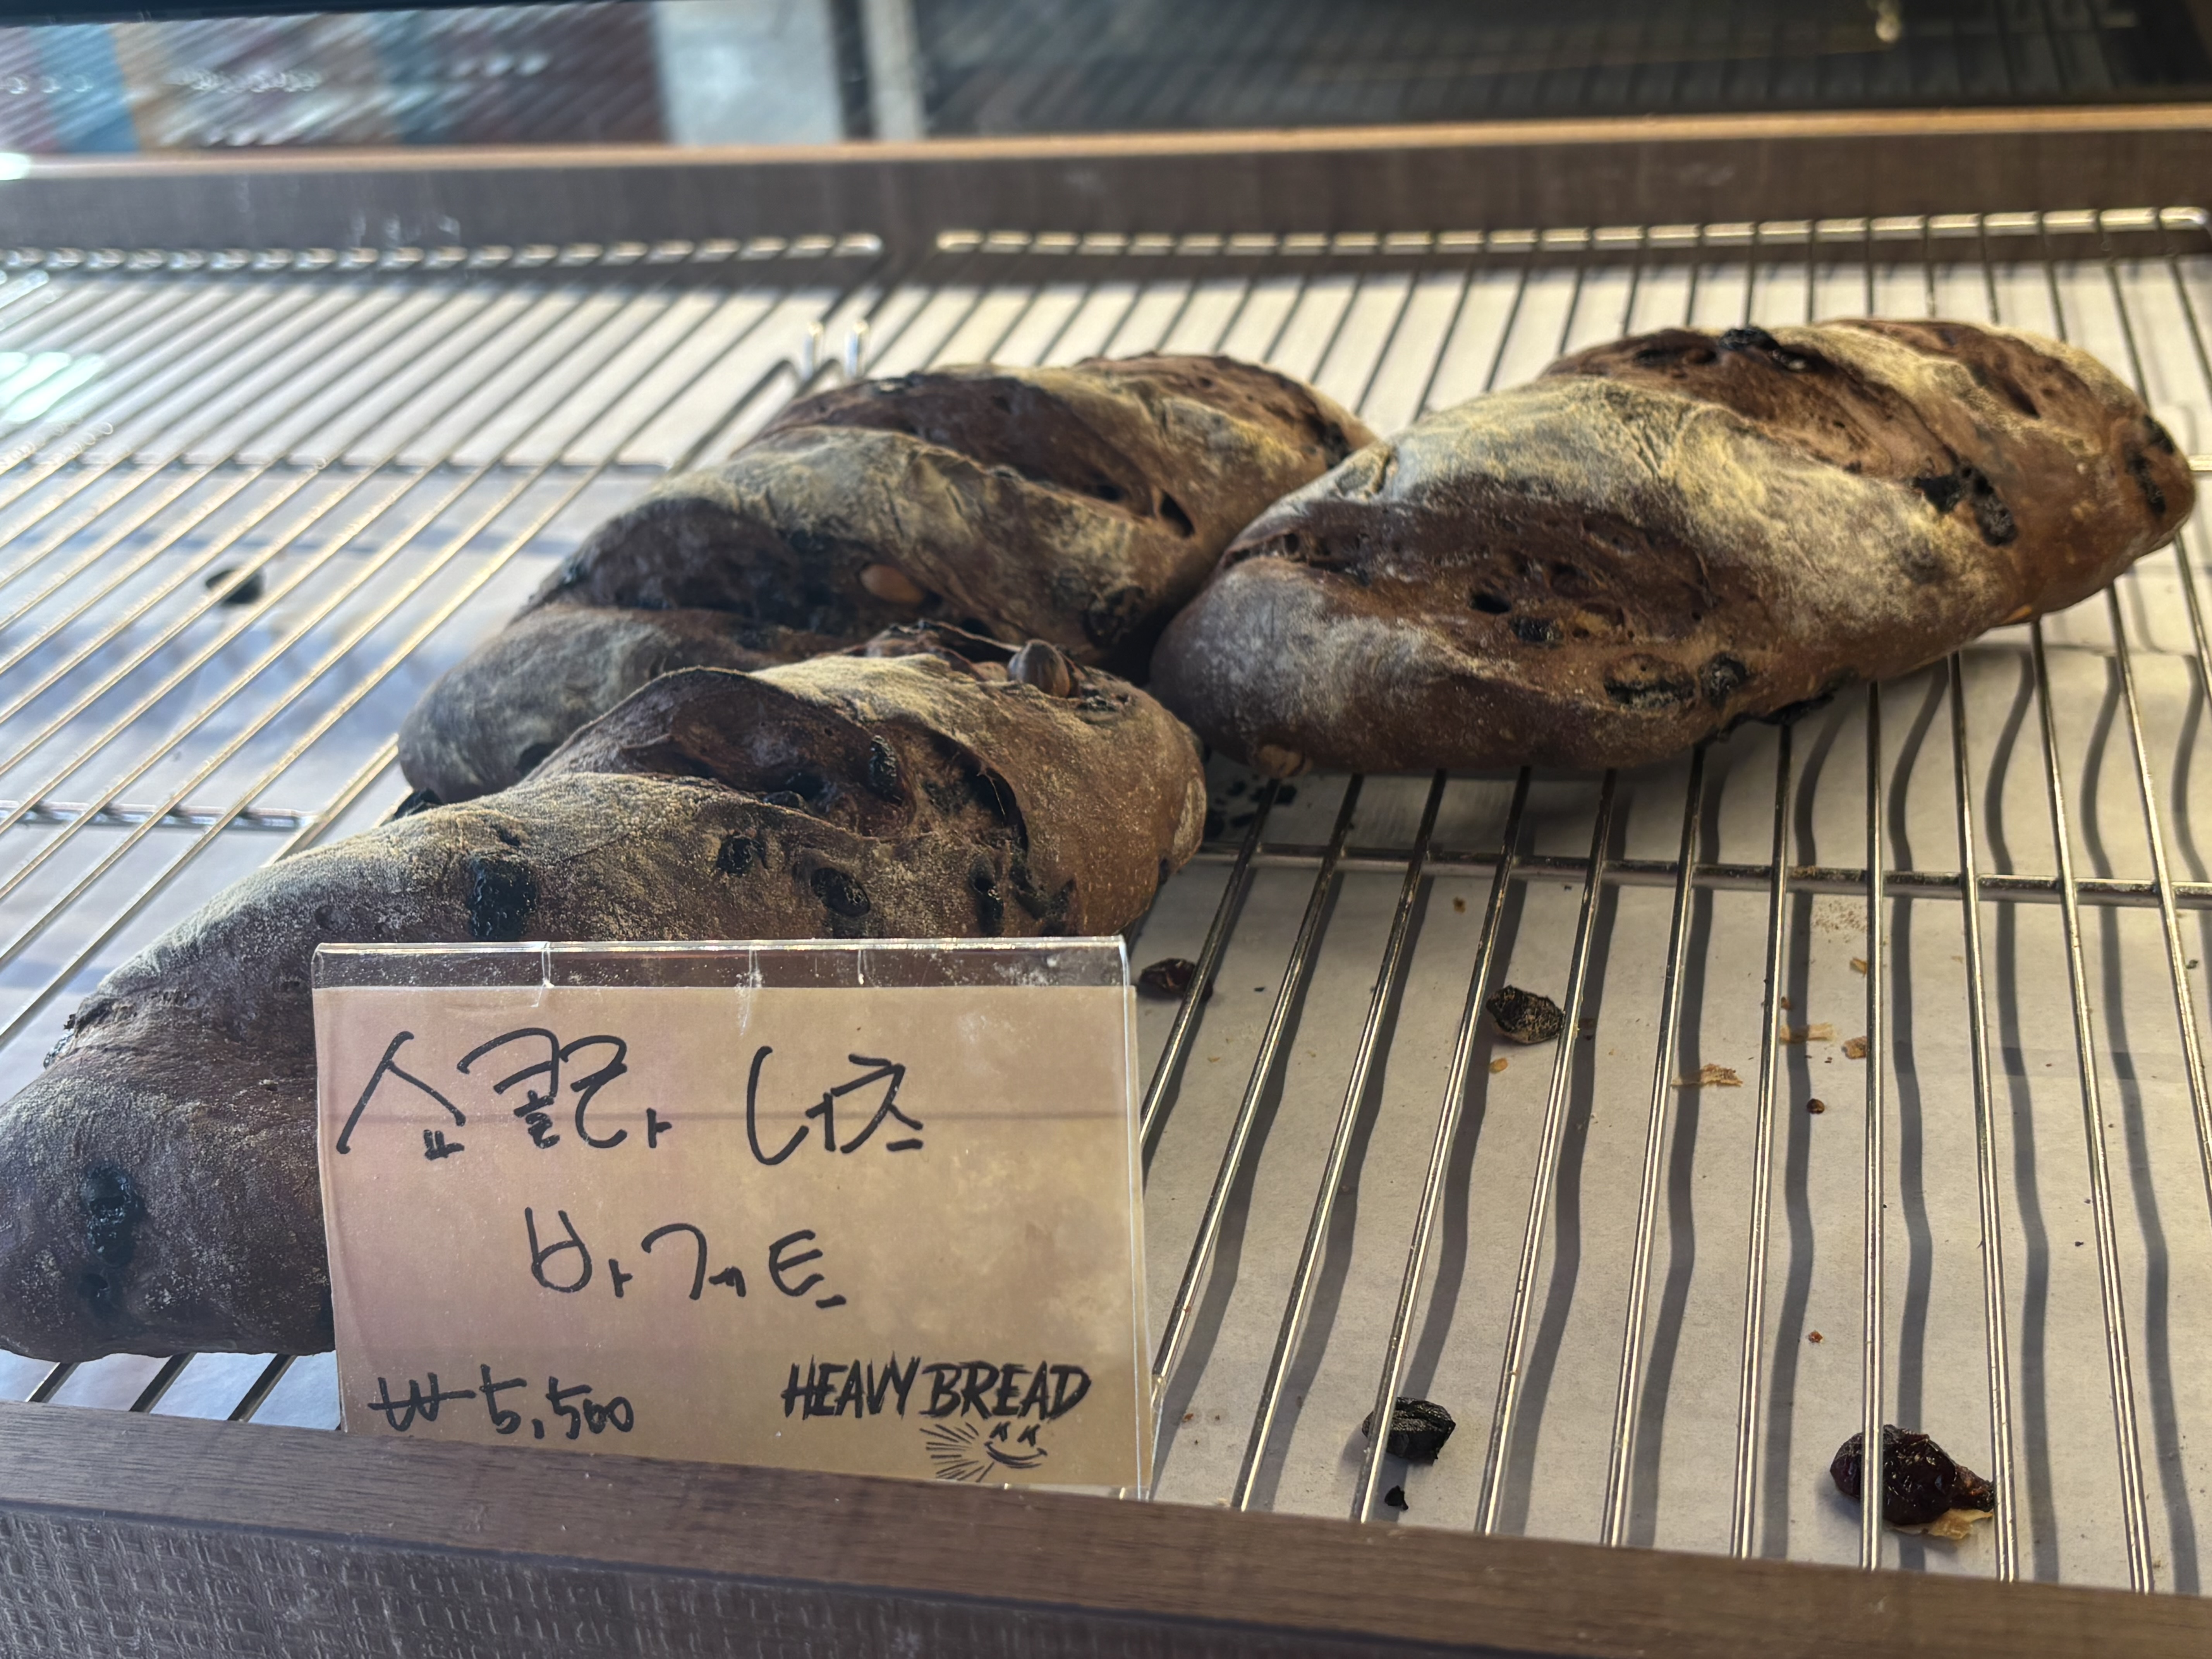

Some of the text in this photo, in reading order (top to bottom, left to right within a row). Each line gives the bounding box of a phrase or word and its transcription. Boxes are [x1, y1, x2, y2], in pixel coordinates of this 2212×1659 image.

[336, 1027, 923, 1166] 쇼콜라 너츠
[525, 1207, 847, 1309] 바게트
[780, 1351, 1092, 1423] HEAVY BREAD
